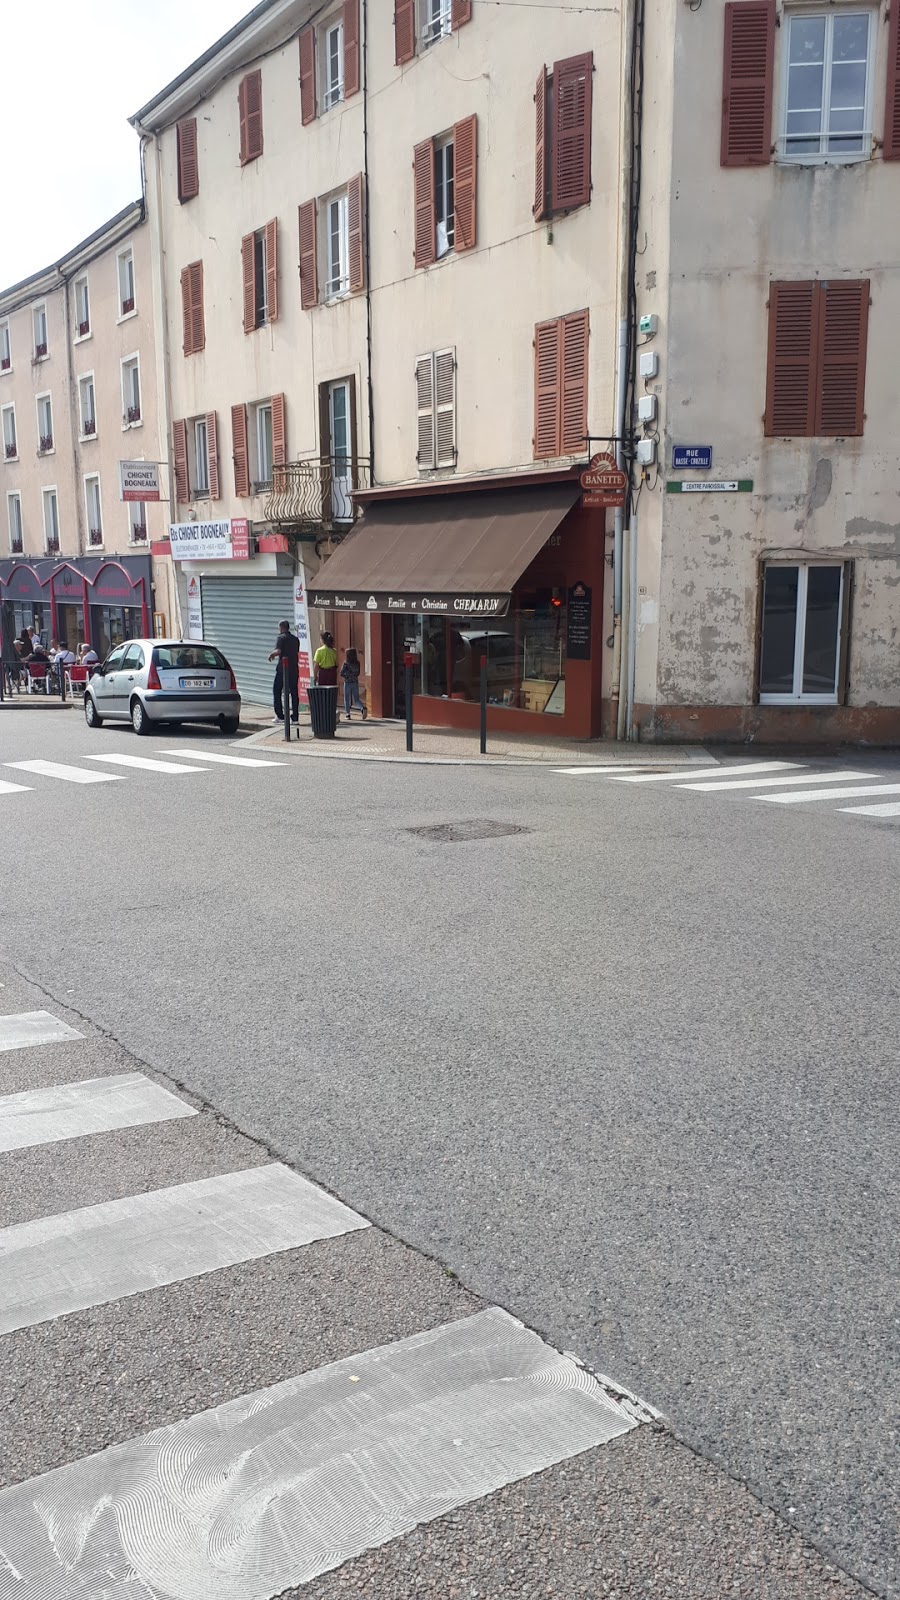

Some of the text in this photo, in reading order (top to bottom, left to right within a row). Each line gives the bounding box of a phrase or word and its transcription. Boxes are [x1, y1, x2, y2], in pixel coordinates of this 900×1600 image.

[686, 449, 699, 457] RUE
[127, 471, 153, 479] CHIGNET
[124, 479, 158, 487] BOGNEAUX
[585, 475, 623, 484] BANETTE
[170, 527, 178, 541] Ets
[178, 525, 199, 541] CHIGNET
[313, 594, 331, 606] Artisan
[334, 595, 357, 609] Boulanger
[411, 601, 417, 609] et
[421, 597, 448, 610] Christian
[453, 598, 500, 612] CHEMARIN
